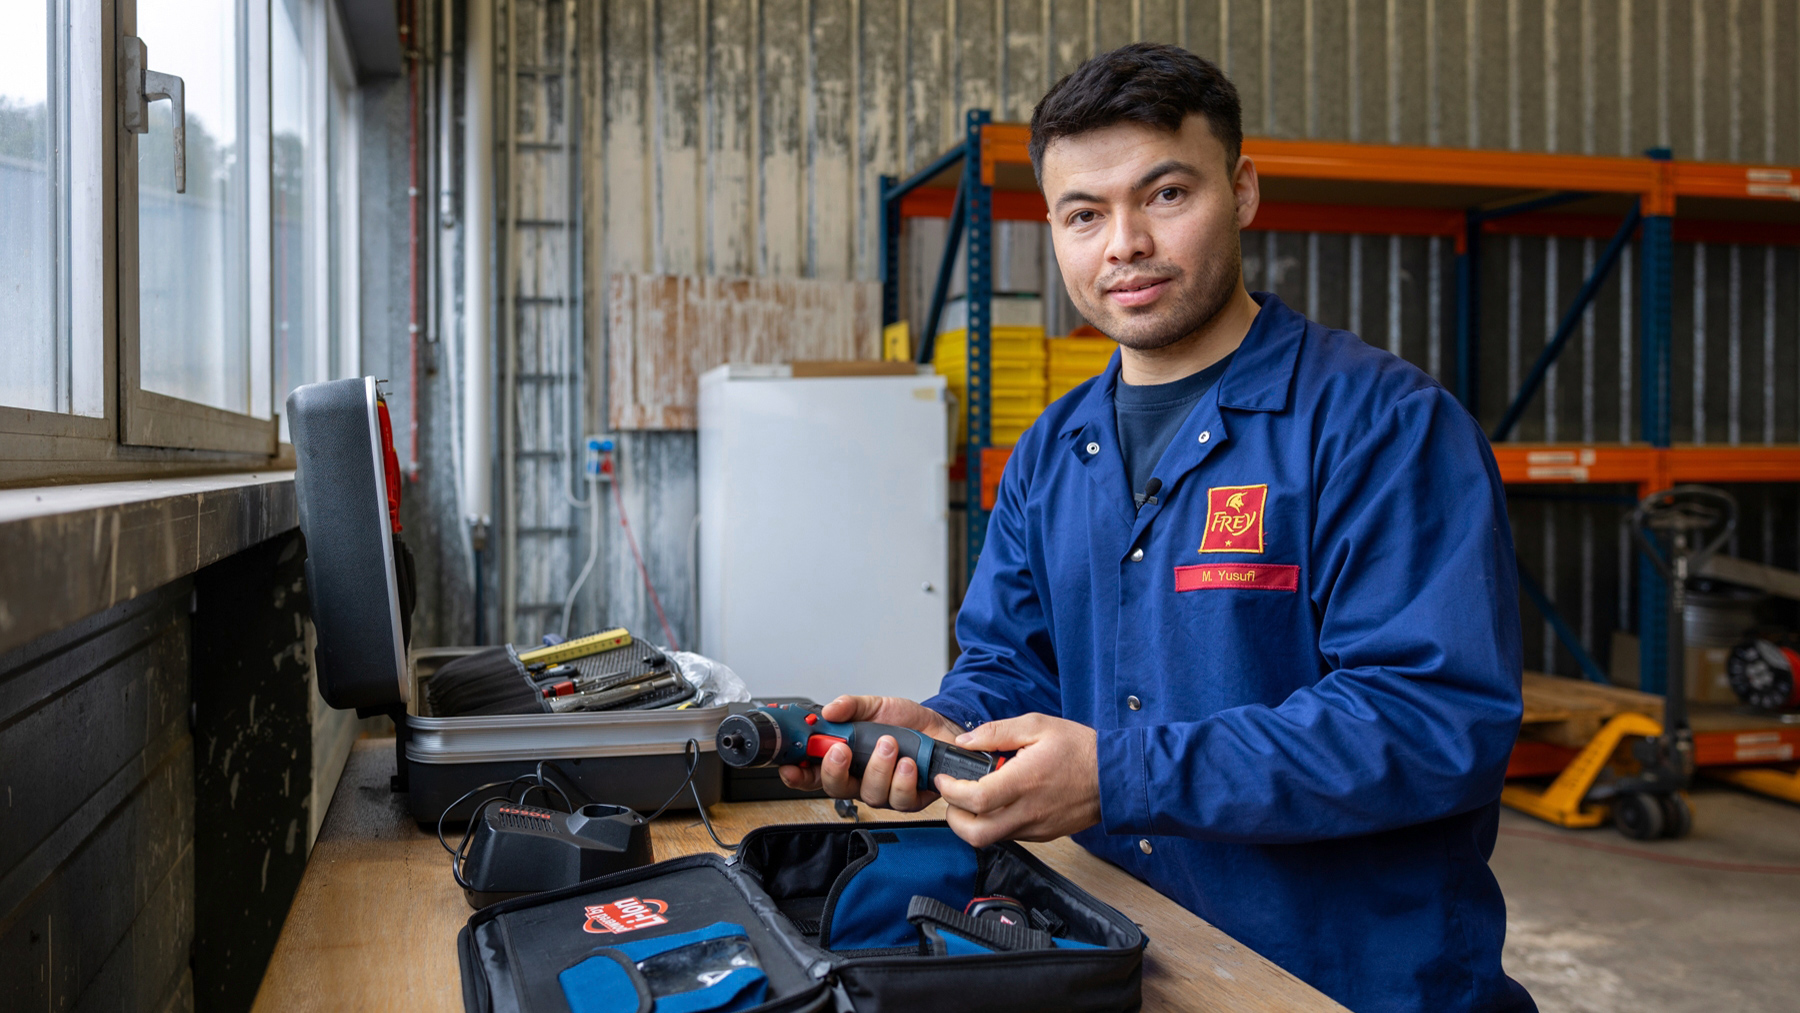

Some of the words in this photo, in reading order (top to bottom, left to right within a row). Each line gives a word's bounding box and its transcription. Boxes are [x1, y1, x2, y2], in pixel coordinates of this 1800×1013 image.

[1211, 511, 1257, 536] FREY
[1202, 570, 1213, 582] M.
[1218, 570, 1256, 582] Yusufi
[500, 807, 550, 819] BOSCH
[614, 897, 665, 929] Li-Ion
